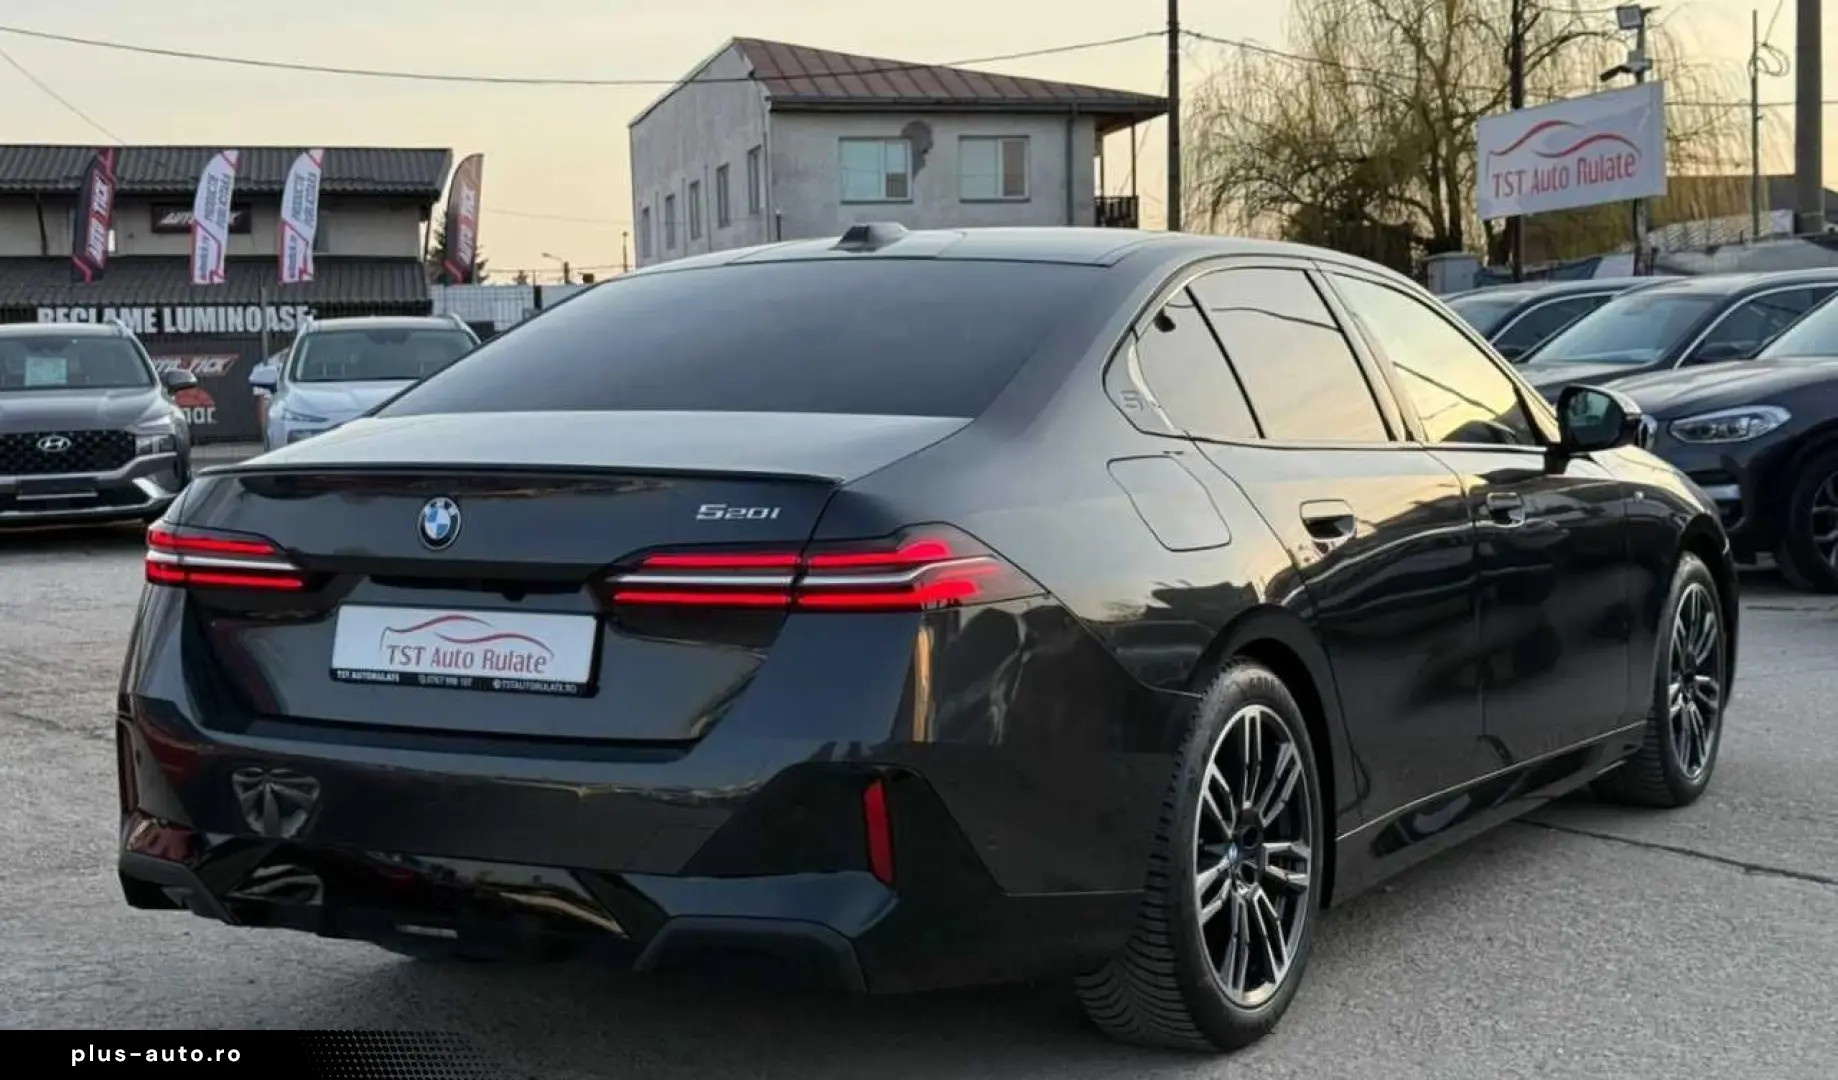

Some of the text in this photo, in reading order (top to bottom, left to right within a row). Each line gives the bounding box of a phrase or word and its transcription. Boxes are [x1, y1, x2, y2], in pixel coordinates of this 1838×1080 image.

[1493, 152, 1636, 198] TST Auto Rulate
[37, 306, 309, 333] RECLAME LUMINOASE
[387, 645, 547, 674] TST Auto Rulate
[337, 671, 350, 679] TST
